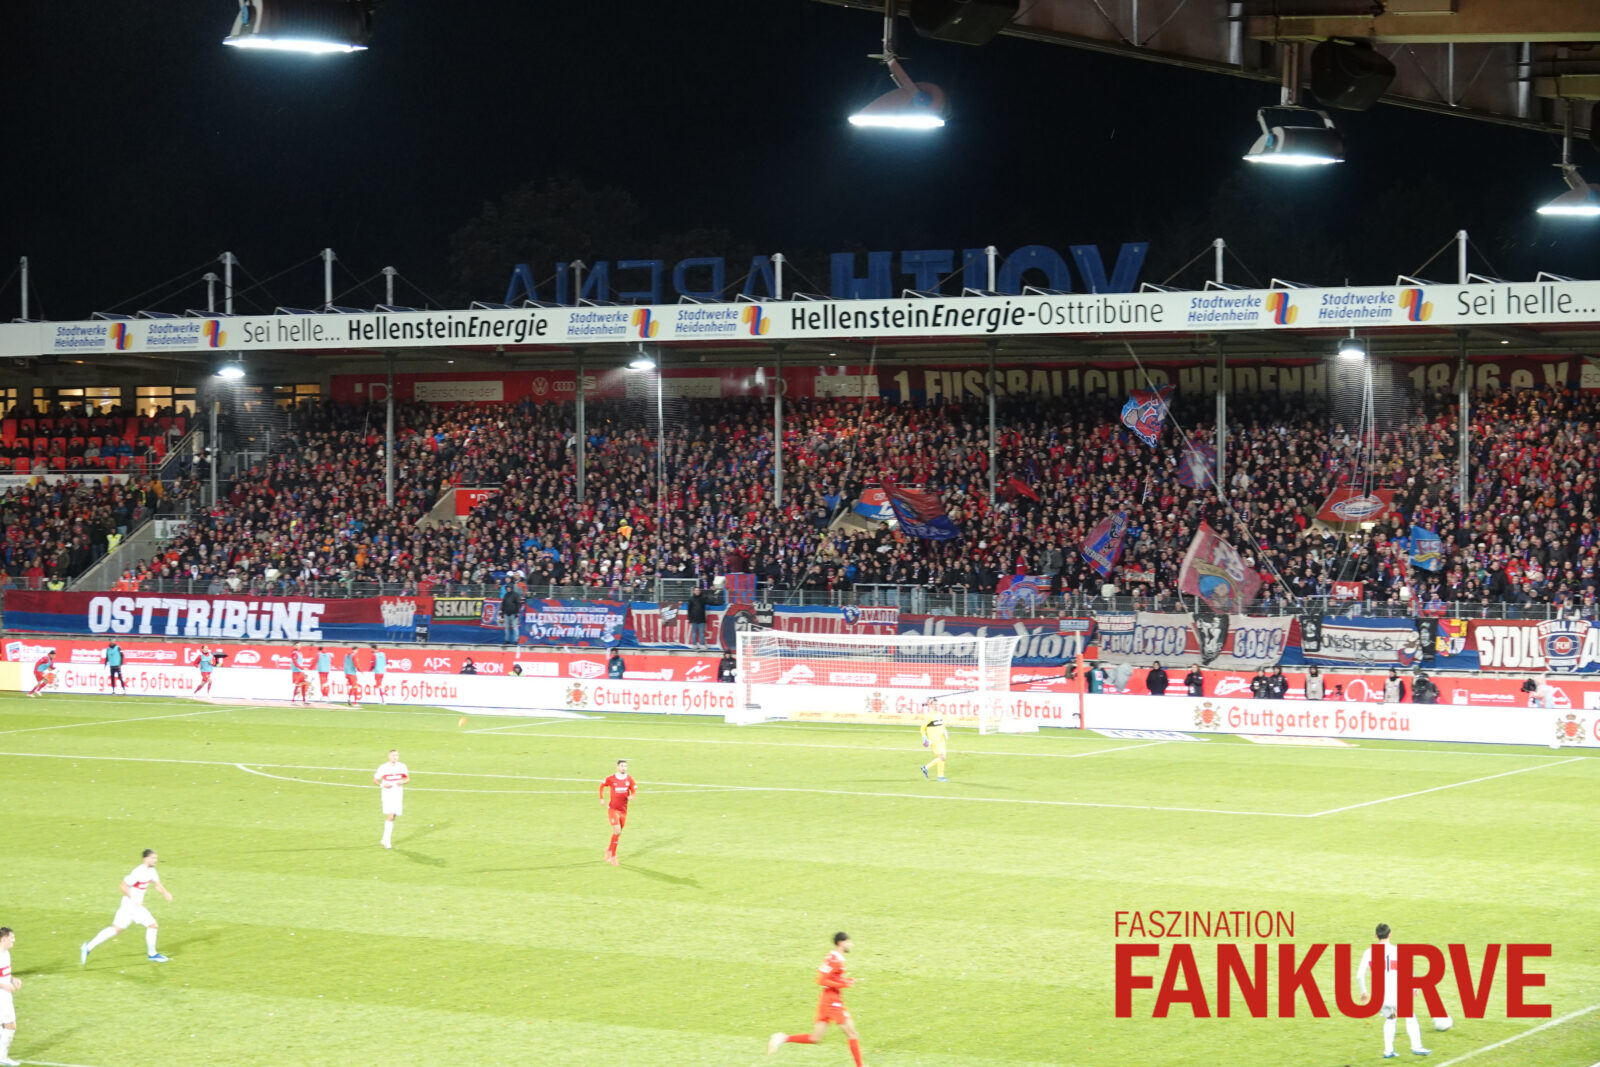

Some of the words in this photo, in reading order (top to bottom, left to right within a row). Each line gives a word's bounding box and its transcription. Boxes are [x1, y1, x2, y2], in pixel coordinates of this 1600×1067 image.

[1191, 295, 1261, 310] Stadtwerke
[1322, 292, 1395, 306] Stadtwerke
[1457, 291, 1495, 316] Sei
[1506, 286, 1596, 314] helle...
[569, 311, 629, 324] Stadtwerke
[678, 308, 738, 321] Stadtwerke
[791, 299, 1164, 332] HellensteinEnergie-Osttribüne
[1187, 310, 1259, 323] Heidenheim
[1318, 305, 1392, 320] Heidenheim
[56, 324, 107, 337] Stadtwerke
[147, 323, 200, 335] Stadtwerke
[243, 320, 269, 343] Sei
[348, 313, 548, 343] HellensteinEnergie
[566, 324, 627, 336] Heidenheim
[675, 321, 736, 333] Heidenheim
[55, 337, 106, 348] Heidenheim
[147, 334, 199, 346] Heidenheim
[140, 671, 194, 692] Hofbräu
[400, 679, 457, 702] Hofbräu
[593, 686, 677, 711] Stuttgarter
[1228, 705, 1330, 733] Stuttgarter
[1335, 709, 1411, 735] Hofbräu
